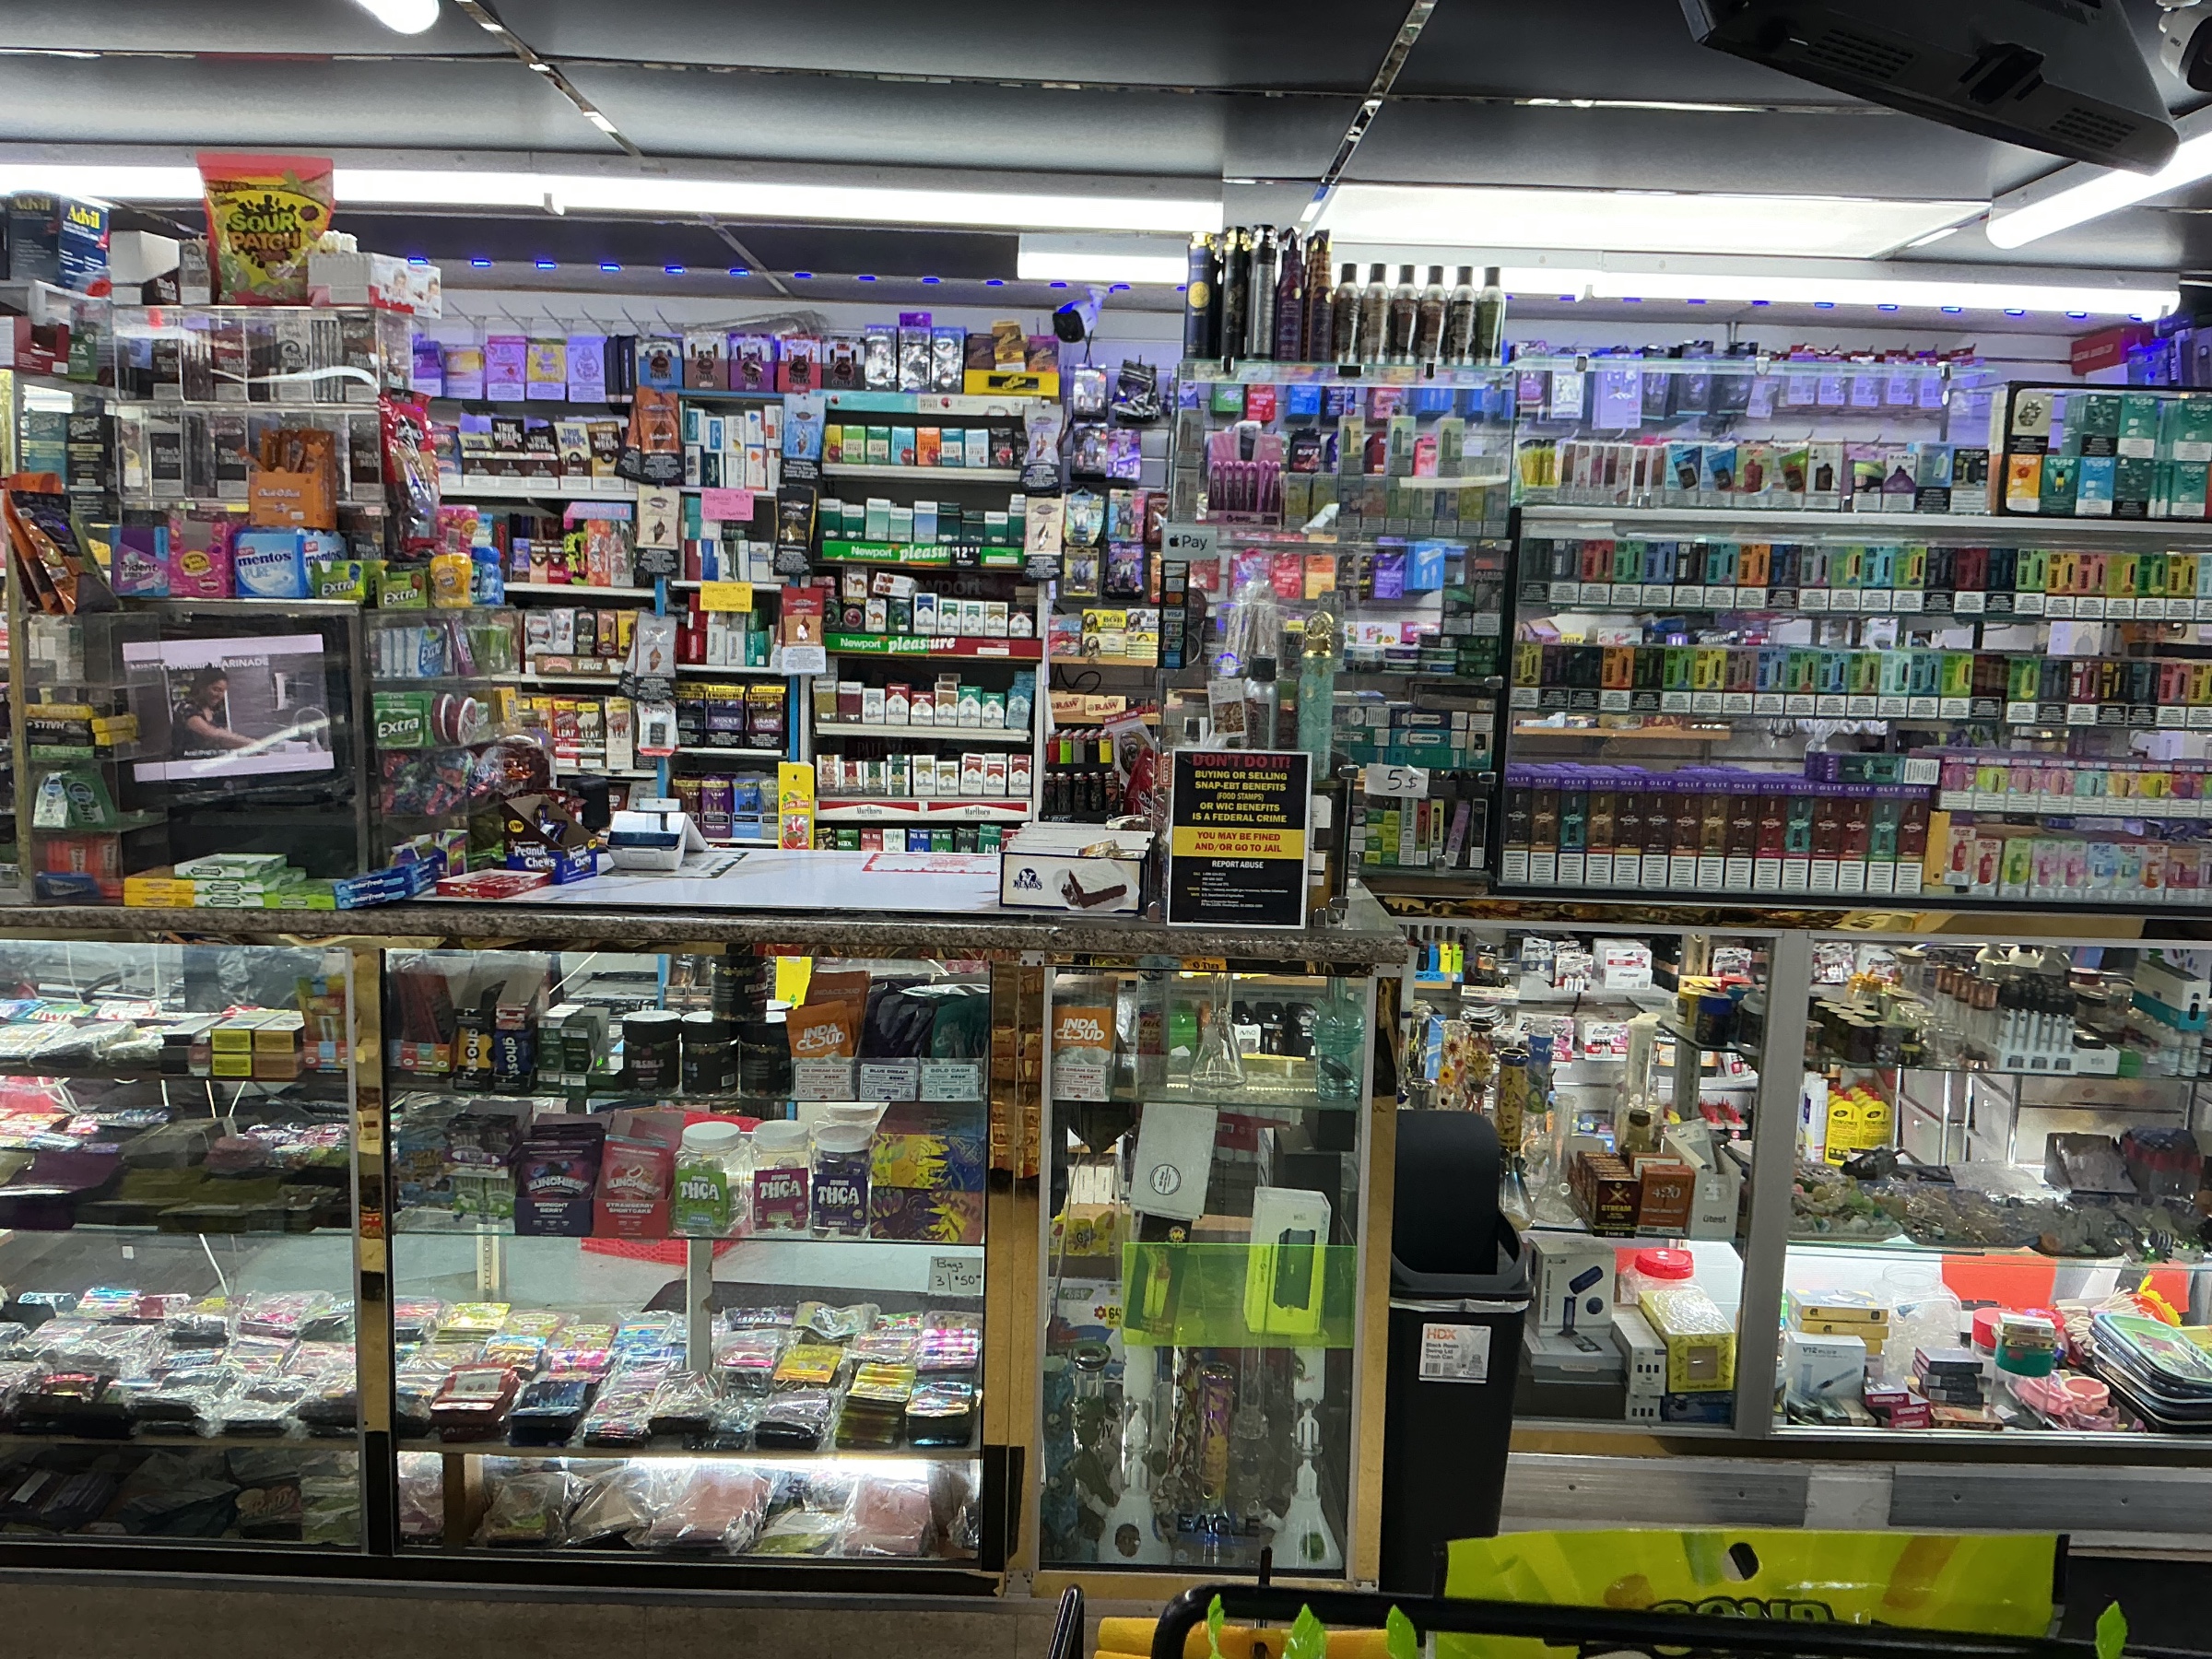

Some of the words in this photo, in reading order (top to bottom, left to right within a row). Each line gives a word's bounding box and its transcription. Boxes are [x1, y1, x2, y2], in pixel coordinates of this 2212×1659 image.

[67, 204, 101, 230] Advil
[229, 211, 298, 232] SOUR
[230, 231, 301, 252] PATCH
[497, 422, 517, 433] TRUE
[493, 432, 523, 443] WRAPS
[596, 432, 615, 441] TRUE
[594, 440, 618, 449] WRAPS
[1182, 535, 1207, 551] Pay
[238, 552, 292, 567] mentos
[851, 545, 893, 558] Newport
[900, 545, 950, 562] pleasu
[120, 562, 158, 573] Trident
[322, 580, 357, 594] Extra
[383, 588, 418, 606] Extra
[840, 637, 881, 650] Newport
[888, 636, 956, 653] pleasure
[1562, 636, 1582, 644] TOP
[1055, 699, 1079, 711] RAW
[1094, 701, 1119, 712] RAW
[377, 717, 420, 738] Extra
[557, 728, 576, 738] LEAF
[581, 730, 600, 740] LEAF
[1193, 754, 1241, 768] DON'T
[1244, 754, 1269, 768] DO
[1271, 756, 1291, 770] IT!
[1194, 771, 1230, 779] BUYING
[1232, 771, 1246, 780] OR
[1248, 771, 1288, 781] SELLING
[1194, 781, 1241, 791] SNAP-EBT
[1242, 782, 1287, 792] BENEFITS
[1217, 792, 1236, 801] (FOOD
[1237, 793, 1265, 802] STAMPS)
[856, 806, 883, 816] Marlboro
[964, 806, 991, 816] Marlboro
[1199, 802, 1214, 810] OR
[1216, 802, 1234, 810] WIC
[1236, 803, 1280, 812] BENEFITS
[1050, 815, 1072, 823] BIC
[1192, 812, 1202, 820] IS
[1204, 813, 1211, 821] A
[1213, 813, 1254, 822] FEDERAL
[1256, 814, 1288, 823] CRIME
[1197, 831, 1215, 840] YOU
[1218, 831, 1237, 840] MAY
[1240, 832, 1251, 841] BE
[1253, 832, 1281, 841] FINED
[512, 845, 548, 858] Peanut
[569, 846, 588, 861] Peanut
[1194, 842, 1233, 853] AND/OR
[1235, 843, 1248, 852] GO
[1251, 843, 1261, 852] TO
[1264, 844, 1282, 853] JAIL
[524, 855, 557, 869] Chews
[574, 854, 593, 868] Chews
[1211, 860, 1240, 868] REPORT
[1240, 861, 1265, 869] ABUSE
[1559, 954, 1594, 968] Energizer
[803, 1023, 840, 1038] INDA
[1063, 1018, 1099, 1030] INDA
[1053, 1028, 1105, 1041] CLOUD
[795, 1033, 846, 1052] CLOUD
[465, 1028, 479, 1077] ghost.
[504, 1036, 521, 1081] ghost.
[679, 1182, 719, 1201] THCA
[759, 1180, 801, 1199] THCA
[818, 1185, 860, 1206] THCA
[935, 1258, 964, 1272] Bags
[1426, 1328, 1457, 1340] HDX
